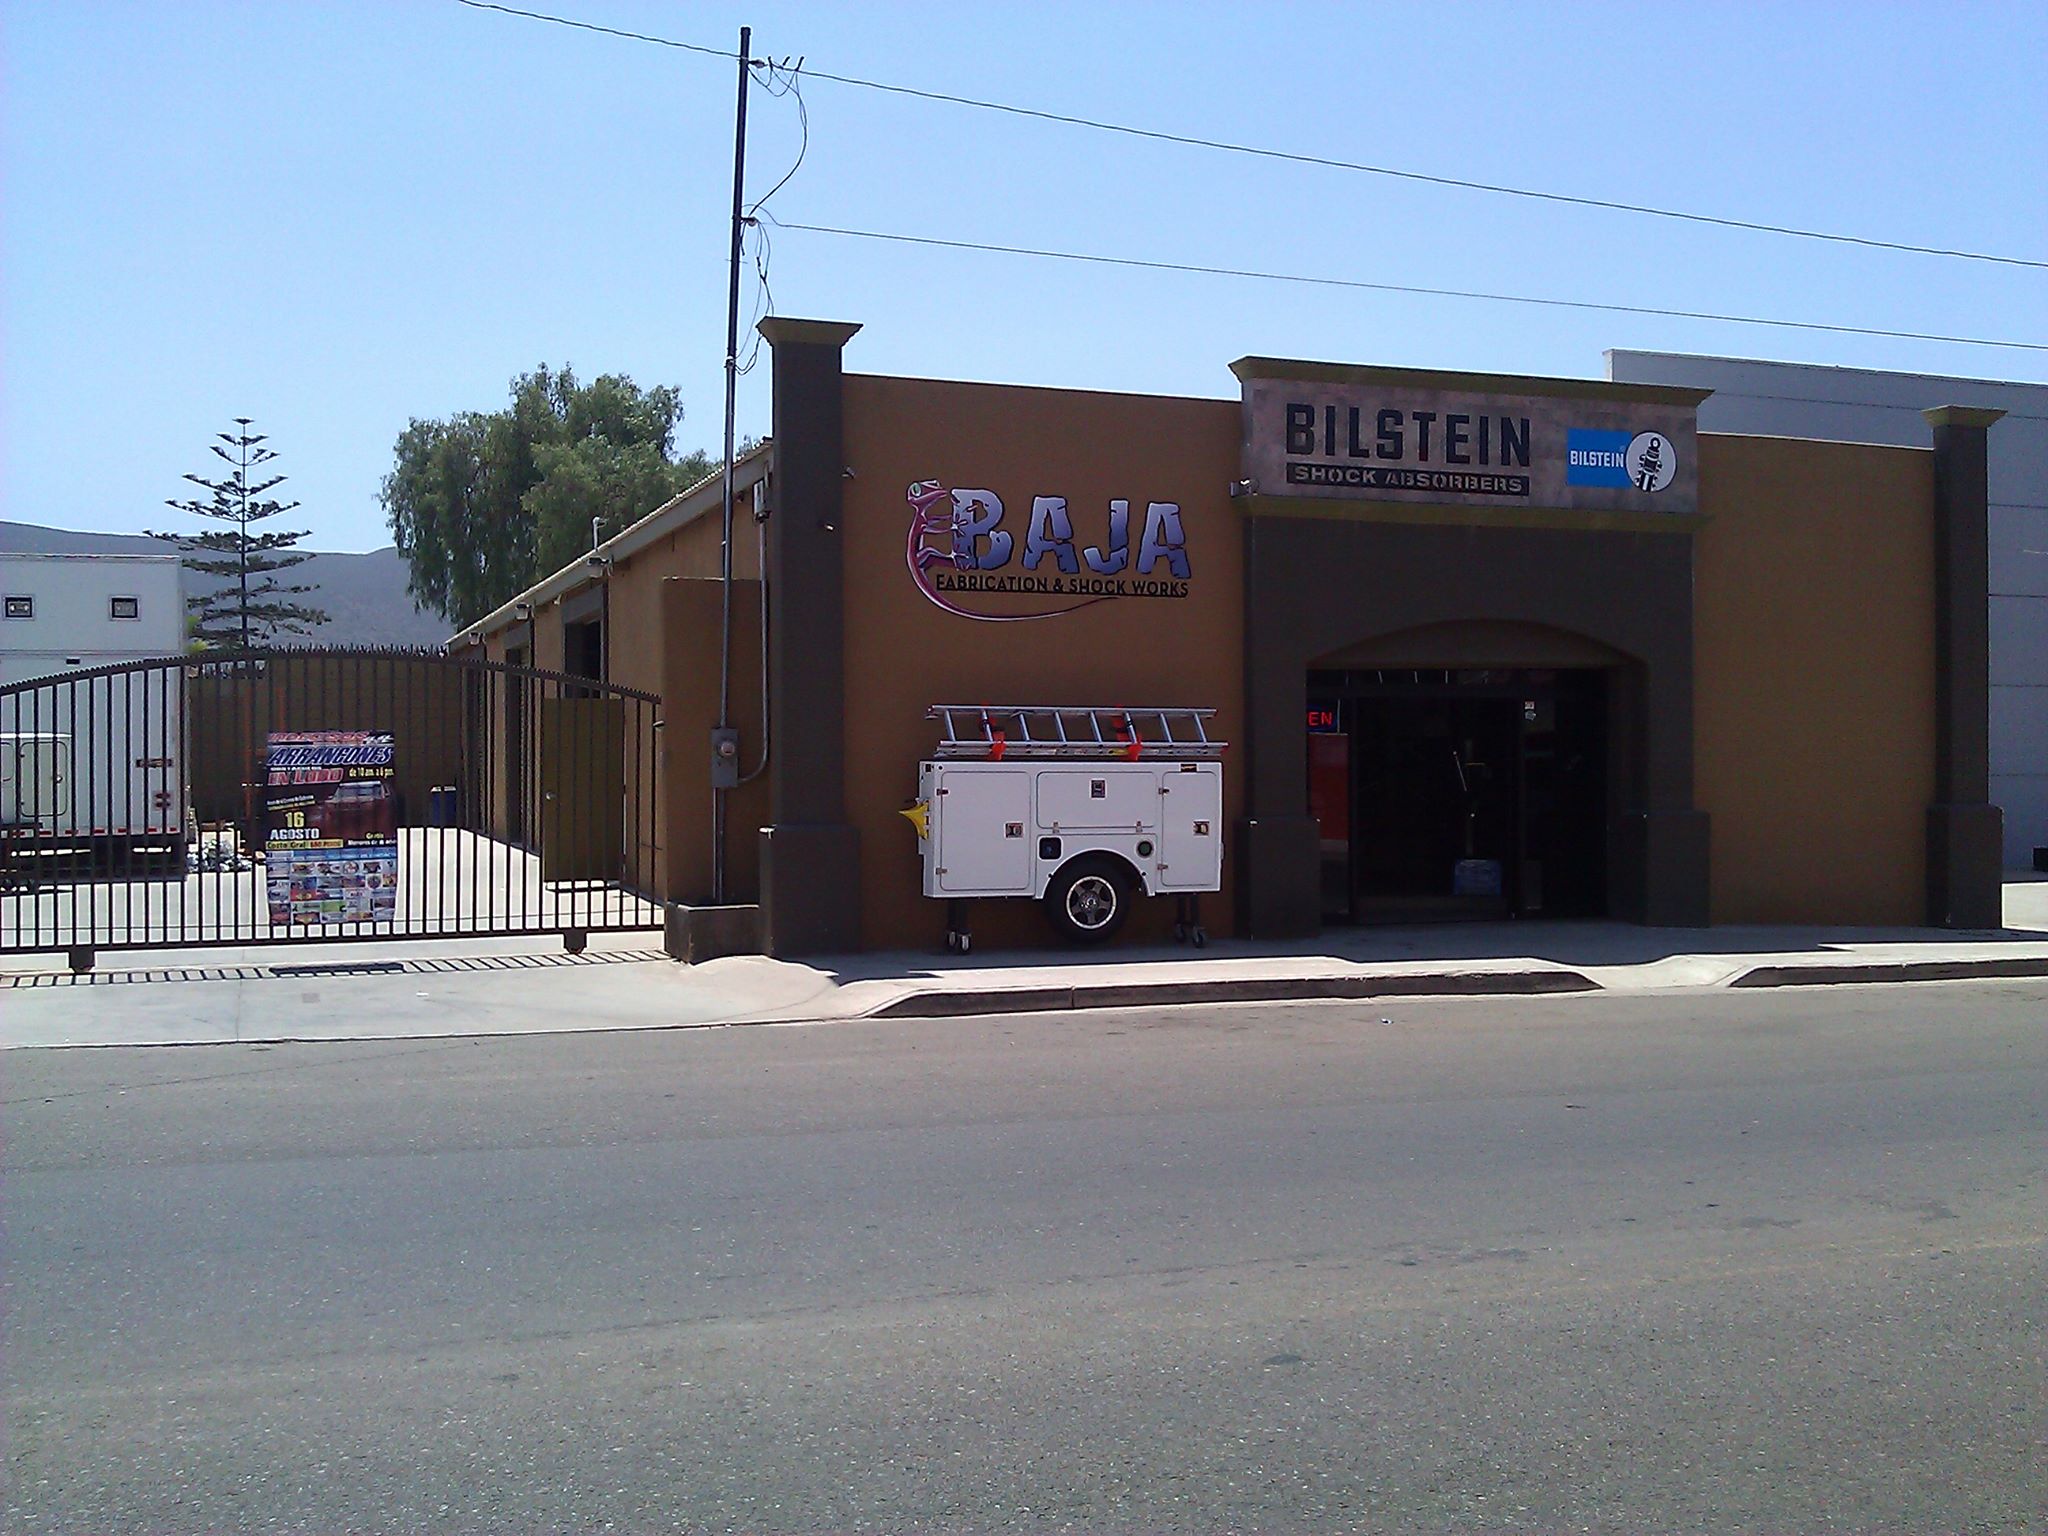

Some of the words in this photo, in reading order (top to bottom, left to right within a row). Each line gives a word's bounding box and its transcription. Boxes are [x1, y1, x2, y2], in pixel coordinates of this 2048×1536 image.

[1286, 402, 1530, 467] BILSTEIN
[1570, 450, 1624, 468] BILSTEIN
[1295, 465, 1378, 485] SHOCK
[1385, 470, 1523, 492] ABSORBERS
[950, 488, 1191, 579] BAJA
[936, 574, 1049, 594] FABRICATION
[1052, 579, 1064, 593] &
[1069, 579, 1126, 596] SHOCK
[1131, 580, 1189, 597] WORKS
[266, 746, 394, 766] ARRANCONES
[285, 811, 305, 828] 16
[270, 828, 320, 840] AGOSTO
